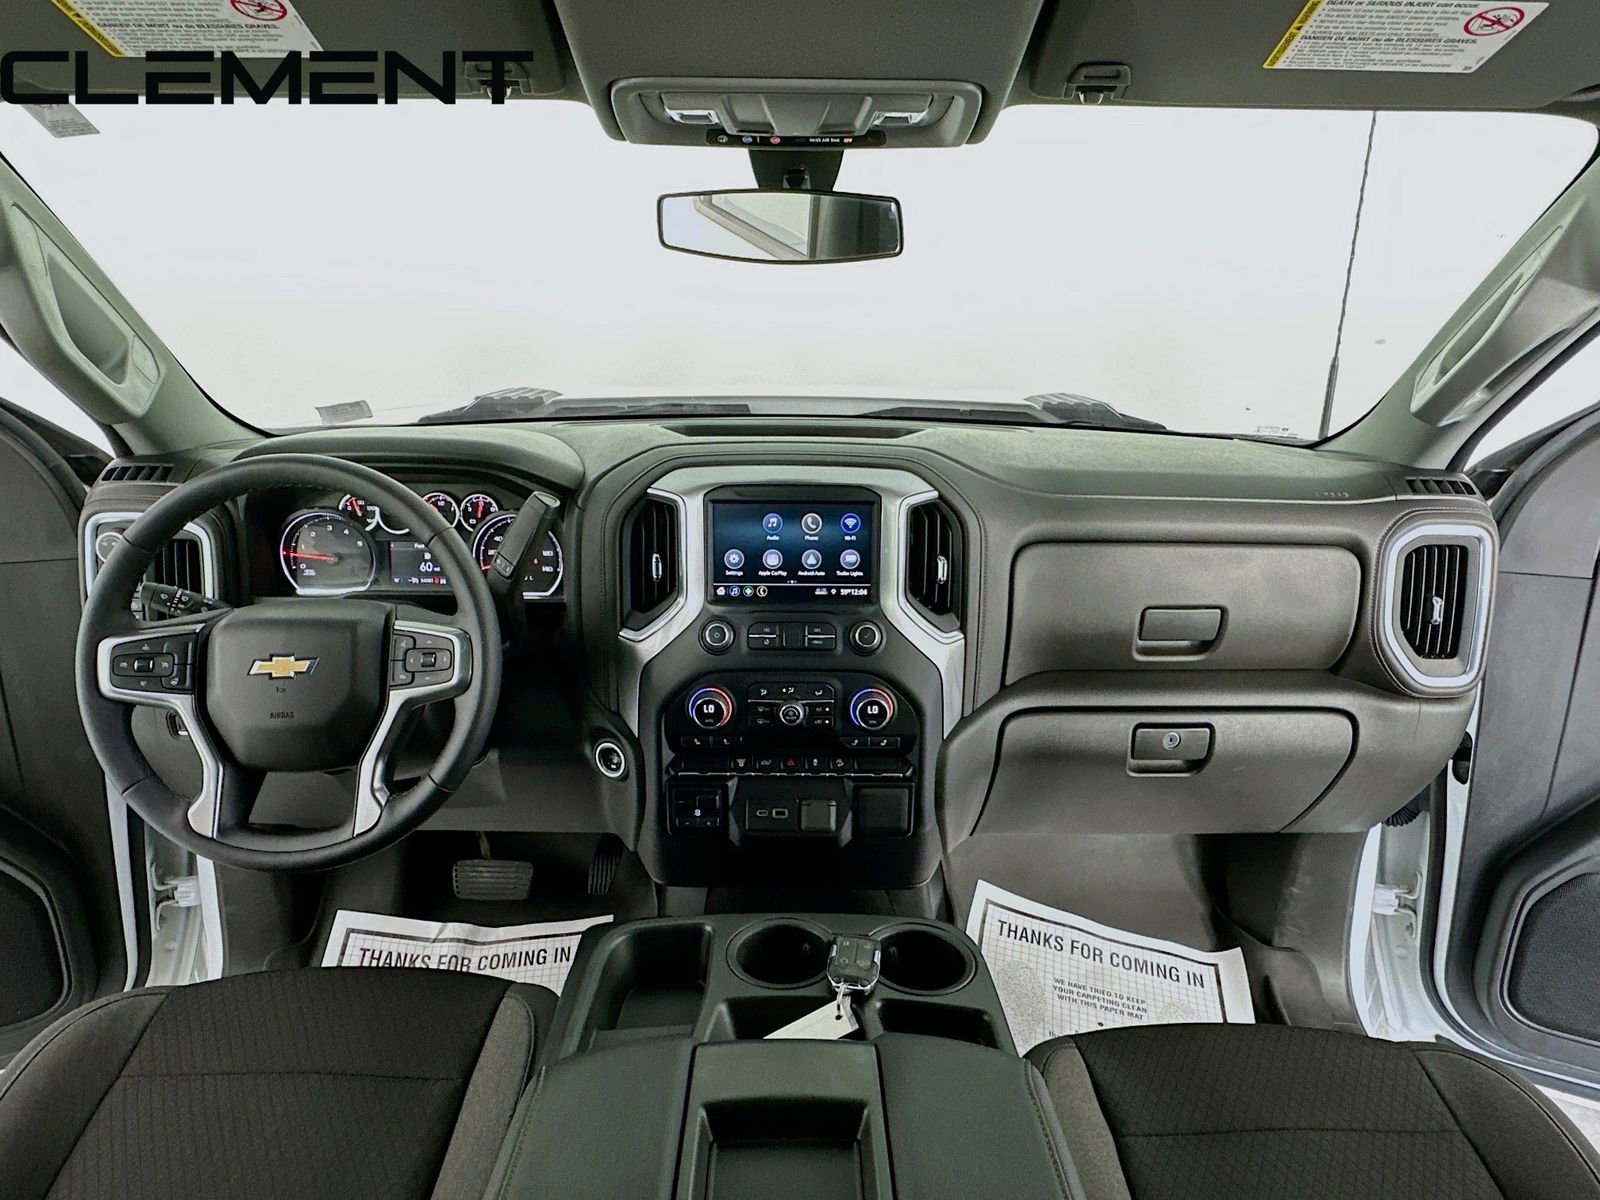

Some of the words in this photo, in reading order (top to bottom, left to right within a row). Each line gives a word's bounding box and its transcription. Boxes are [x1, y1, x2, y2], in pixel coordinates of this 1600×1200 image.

[419, 561, 433, 572] 60
[703, 704, 715, 713] LO
[867, 705, 879, 714] LO
[360, 947, 432, 969] THANKS
[437, 954, 472, 973] FOR
[477, 949, 547, 972] COMING
[553, 946, 572, 964] IN
[998, 919, 1065, 952] THANKS
[1070, 940, 1104, 965] FOR
[1109, 952, 1181, 983] COMING
[1186, 971, 1206, 989] IN
[1053, 977, 1065, 986] WE
[1067, 979, 1088, 991] HAVE
[1089, 986, 1113, 997] TRIED
[1113, 992, 1124, 1000] TO
[1126, 996, 1146, 1005] KEEP
[1053, 985, 1075, 995] YOUR
[1076, 990, 1121, 1007] CARPETING
[1121, 1002, 1147, 1013] CLEAN
[1057, 994, 1077, 1004] WITH
[1079, 999, 1098, 1009] THIS
[1099, 1004, 1125, 1016] PAPER
[1127, 1011, 1144, 1020] MAT
